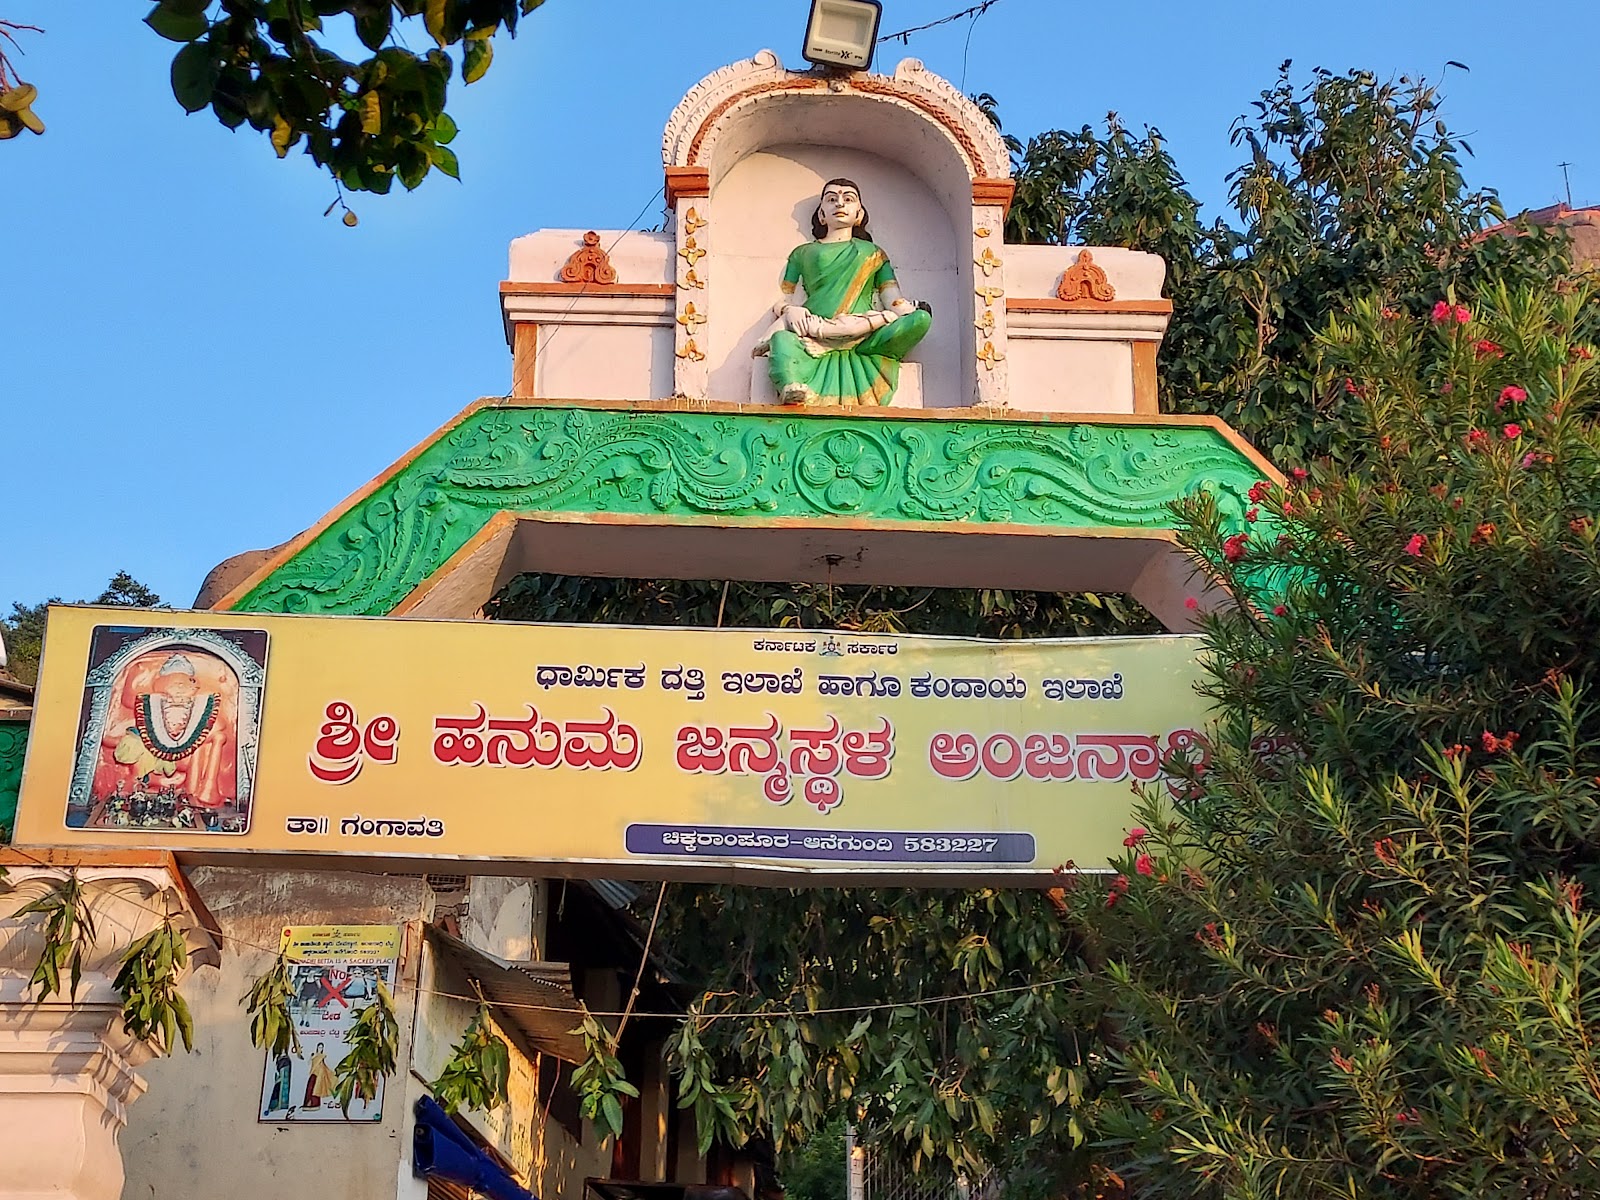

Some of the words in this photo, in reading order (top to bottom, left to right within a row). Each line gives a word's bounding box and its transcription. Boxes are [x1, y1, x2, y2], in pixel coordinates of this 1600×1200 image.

[754, 638, 816, 652] ಕರ್ನಾಟಕ
[847, 641, 898, 655] ಸರ್ಕಾರ
[536, 661, 646, 690] ಧಾರ್ಮಿಕ
[661, 664, 706, 700] ದತ್ತಿ
[721, 667, 803, 694] ಇಲಾಖೆ
[818, 670, 902, 697] ಹಾಗೂ
[910, 671, 1027, 699] ಕಂದಾಯ
[1042, 673, 1124, 701] ಇಲಾಖೆ
[309, 701, 400, 784] ಶ್ರೀ
[433, 702, 643, 770] ಹನುಮ
[676, 712, 894, 812] ಜನ್ಮಸ್ಥಳ
[341, 814, 445, 837] ಗಂಗಾವತಿ
[904, 837, 998, 853] 583227
[330, 969, 347, 980] NO
